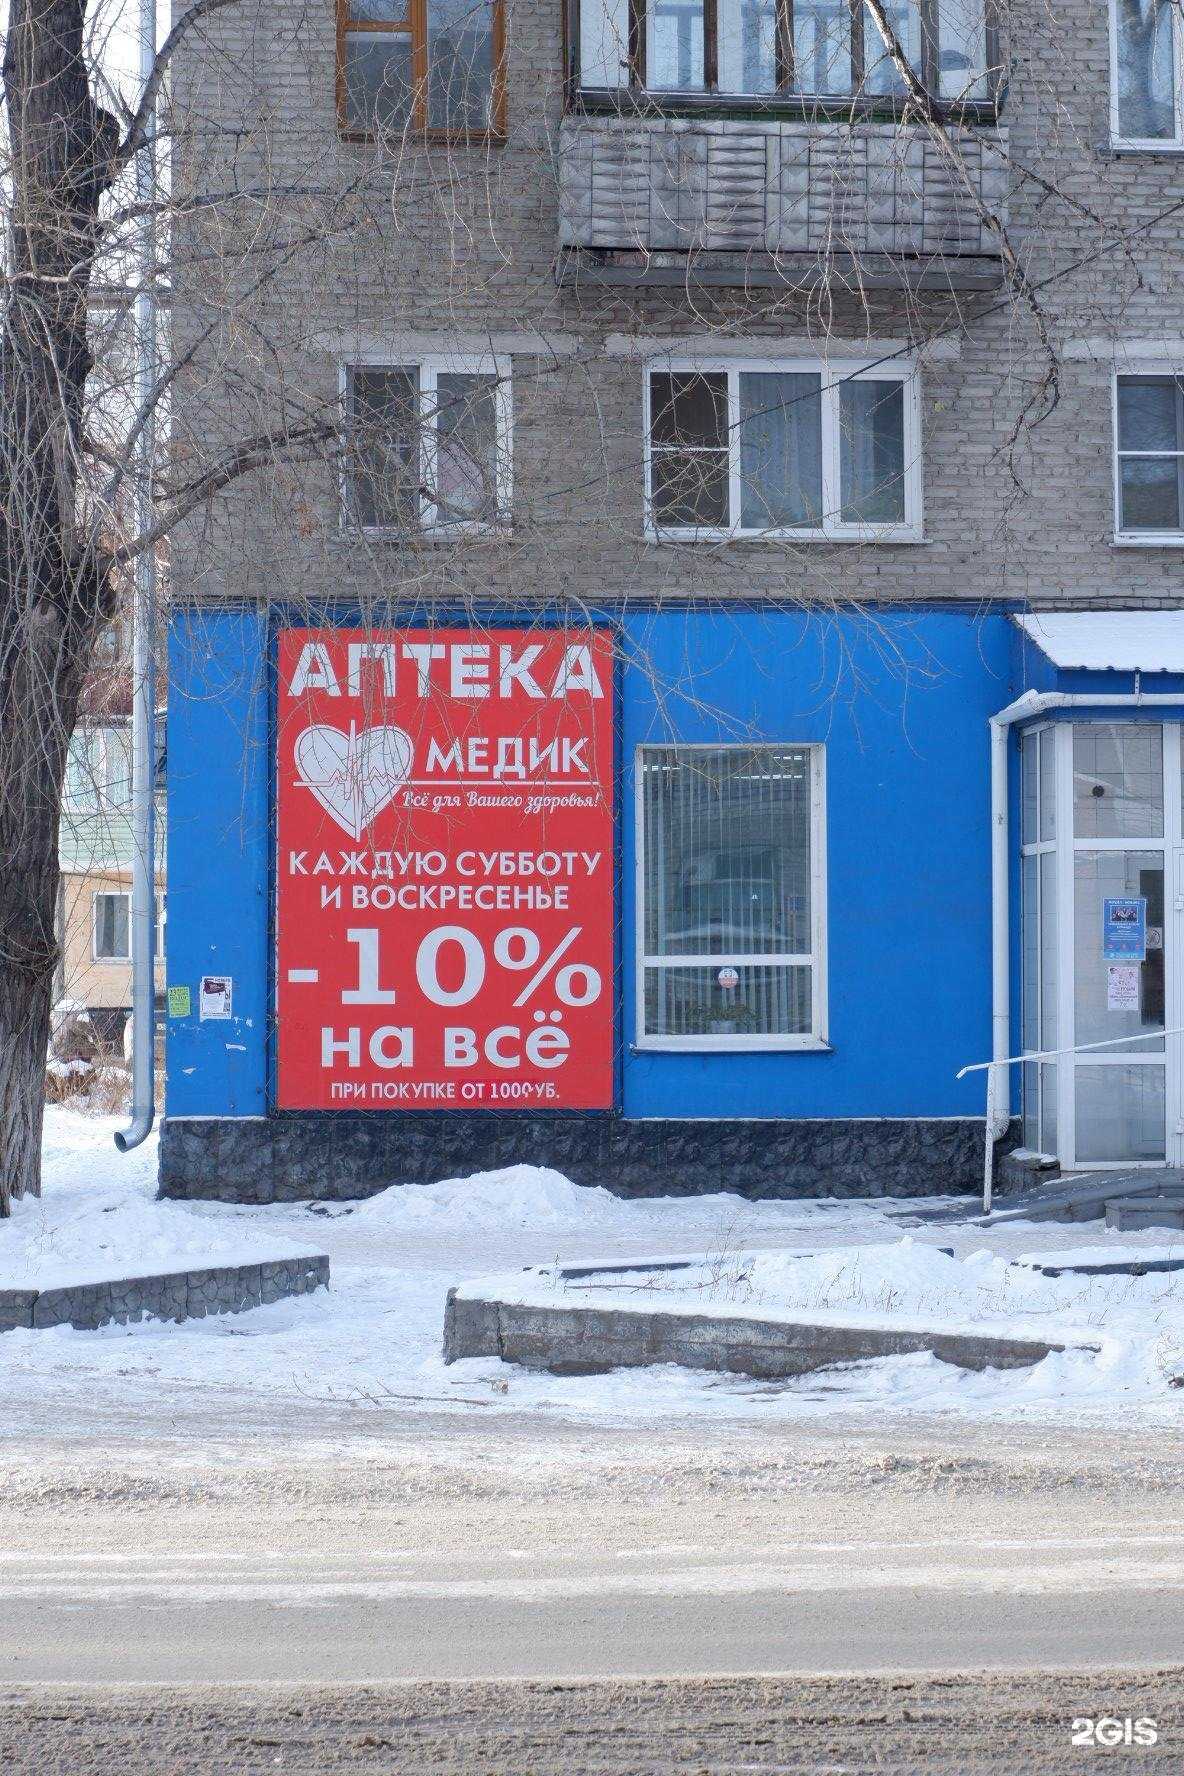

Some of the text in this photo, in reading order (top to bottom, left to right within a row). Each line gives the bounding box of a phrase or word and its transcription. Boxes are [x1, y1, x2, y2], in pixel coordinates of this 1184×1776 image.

[287, 643, 605, 699] АПТЕКА
[425, 736, 590, 779] МЕДИК
[402, 790, 600, 815] Всё для Вашего здоровья!
[289, 851, 602, 880] КАЖДУЮ СУББОТУ
[320, 884, 569, 910] И ВОСКРЕСЕНЬЕ
[321, 1010, 571, 1069] на всё
[331, 1082, 366, 1099] ПРИ
[371, 1082, 455, 1099] ПОКУПКЕ
[461, 1082, 485, 1099] ОТ
